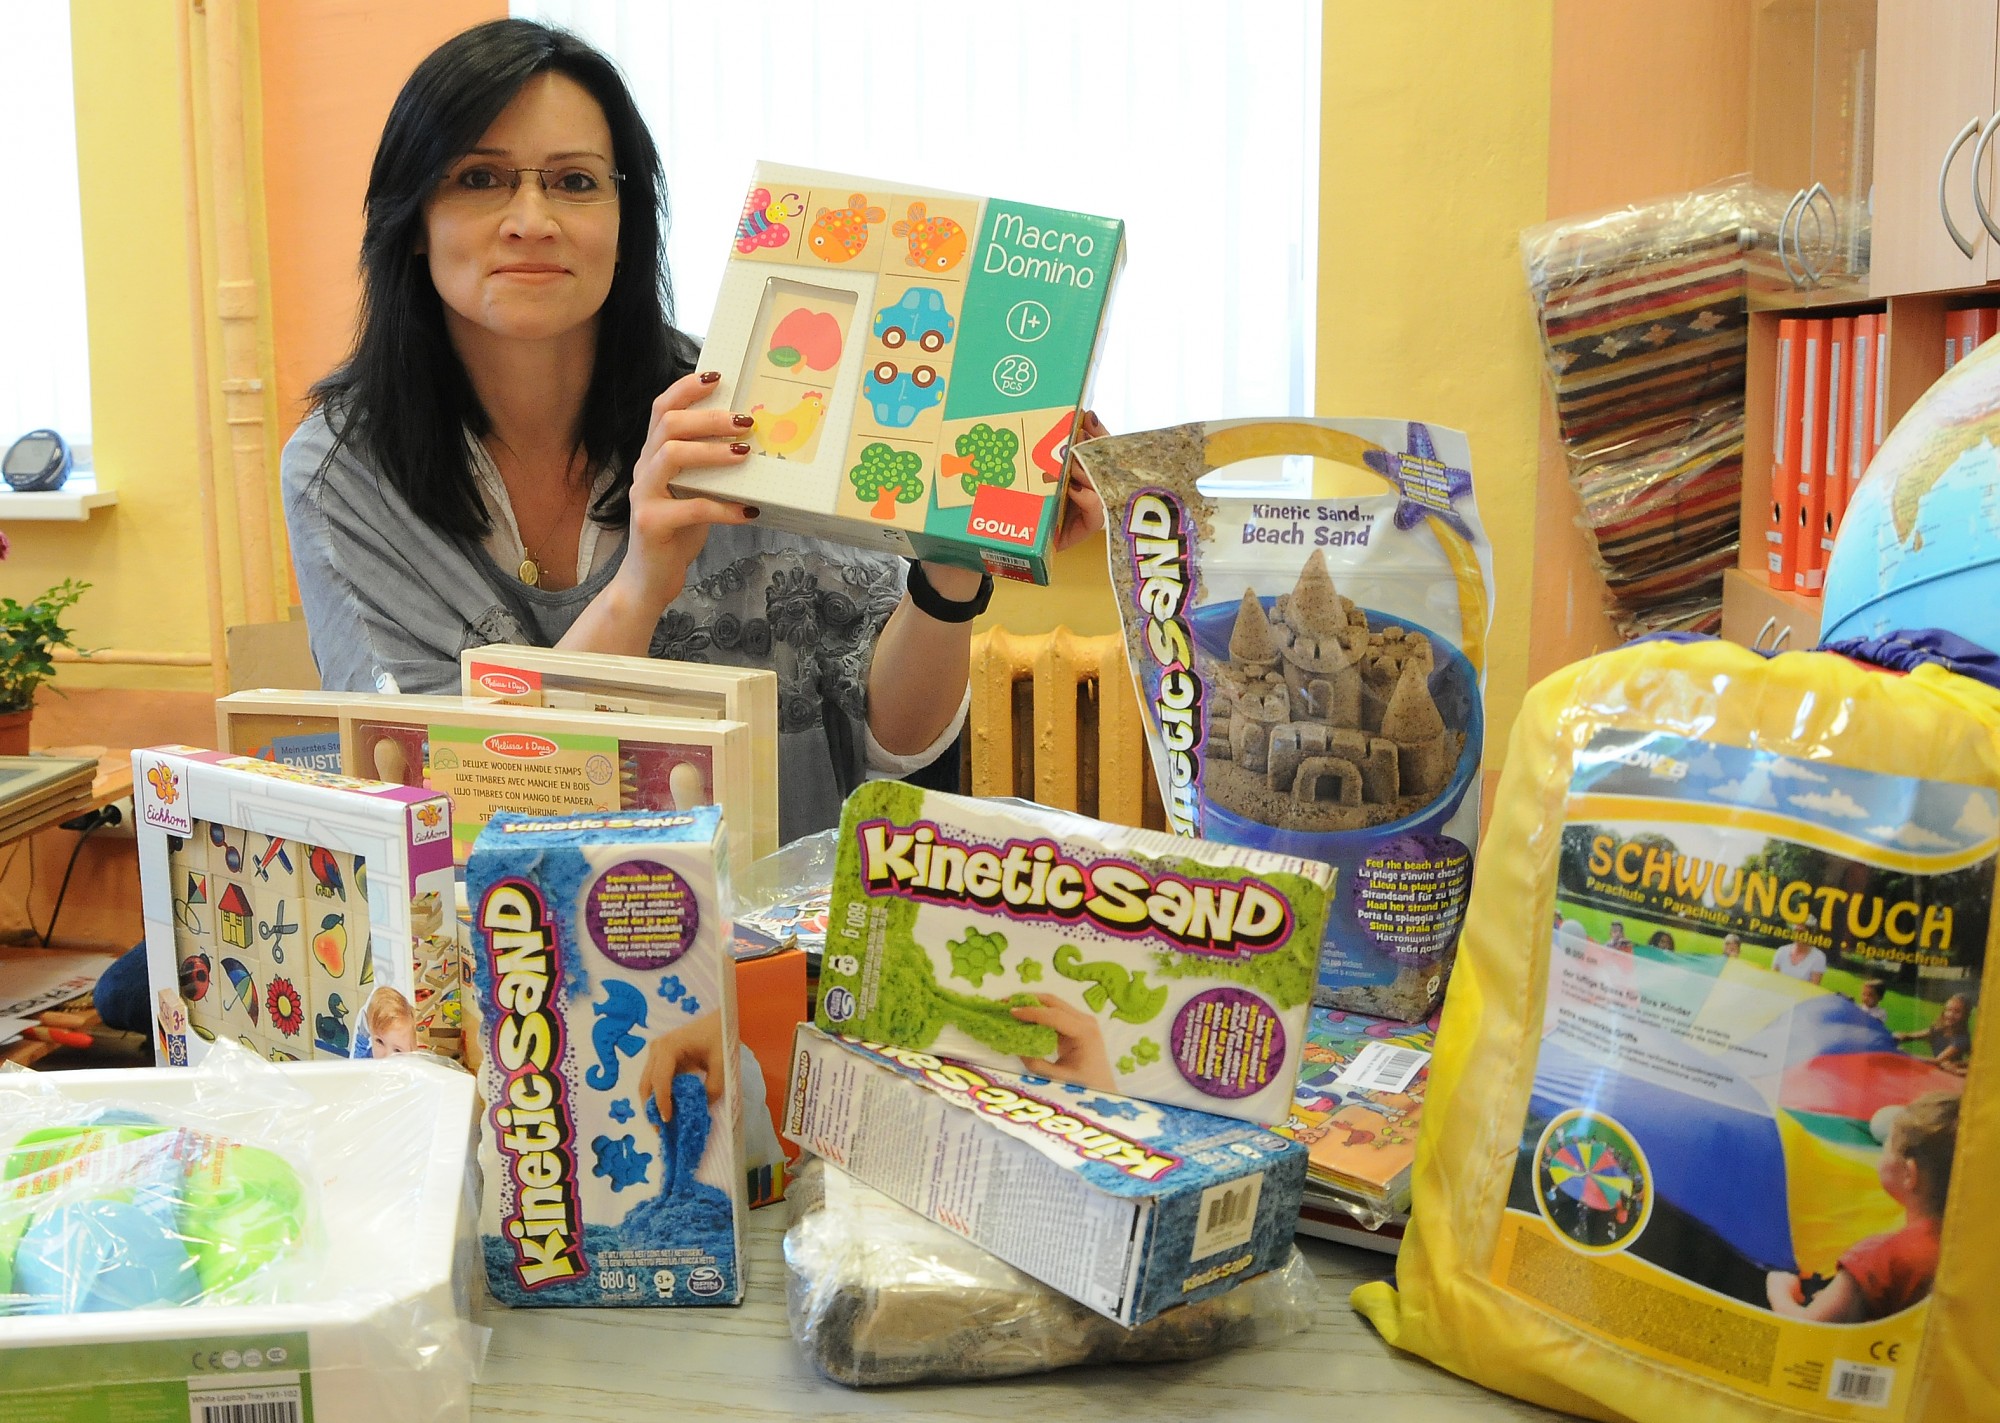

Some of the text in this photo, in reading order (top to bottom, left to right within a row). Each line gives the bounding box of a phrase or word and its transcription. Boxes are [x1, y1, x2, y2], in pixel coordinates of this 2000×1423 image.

[991, 212, 1094, 257] Macro
[984, 242, 1094, 289] Domino
[1019, 307, 1040, 335] 1+
[1000, 359, 1030, 383] 28
[1002, 379, 1022, 391] pcs
[1253, 504, 1311, 521] Kinetic
[1242, 523, 1370, 546] Beach Sand
[281, 745, 300, 754] Mein
[491, 738, 523, 751] Melissa
[531, 742, 552, 755] Doug
[462, 760, 582, 776] DELUXE WOODEN HANDLE STAMPS
[455, 773, 590, 791] LUXE TIMBRES AVEC MANCHE EN BOIS
[453, 787, 594, 806] LUJO TIMBRES CON MANGO DE MADERA
[146, 804, 188, 829] Eichhorn
[414, 829, 448, 843] Eichhorn
[1366, 859, 1384, 868] Feel
[1387, 860, 1401, 870] the
[1405, 861, 1431, 870] beach
[1359, 869, 1455, 882] La plage s'invite chez
[1362, 890, 1415, 901] Strandsand
[1418, 892, 1432, 901] für
[1399, 881, 1408, 891] la
[1411, 882, 1437, 893] playa
[1588, 834, 1953, 950] SCHWUNGTUCH
[1367, 900, 1387, 910] Haal
[1390, 901, 1405, 912] het
[1408, 902, 1438, 912] strand
[1586, 876, 1645, 903] Parachute
[1663, 896, 1731, 924] Parachute
[841, 902, 867, 939] 680 g
[1358, 910, 1382, 920] Porta
[1384, 911, 1394, 920] la
[1396, 914, 1434, 924] spiaggia
[1370, 922, 1394, 931] Sinta
[1406, 925, 1430, 934] praia
[1376, 933, 1430, 943] Настоящий
[1396, 945, 1418, 953] тебя
[1660, 1001, 1691, 1017] Kinder
[173, 1010, 185, 1031] 3+
[600, 1271, 636, 1292] 680 g
